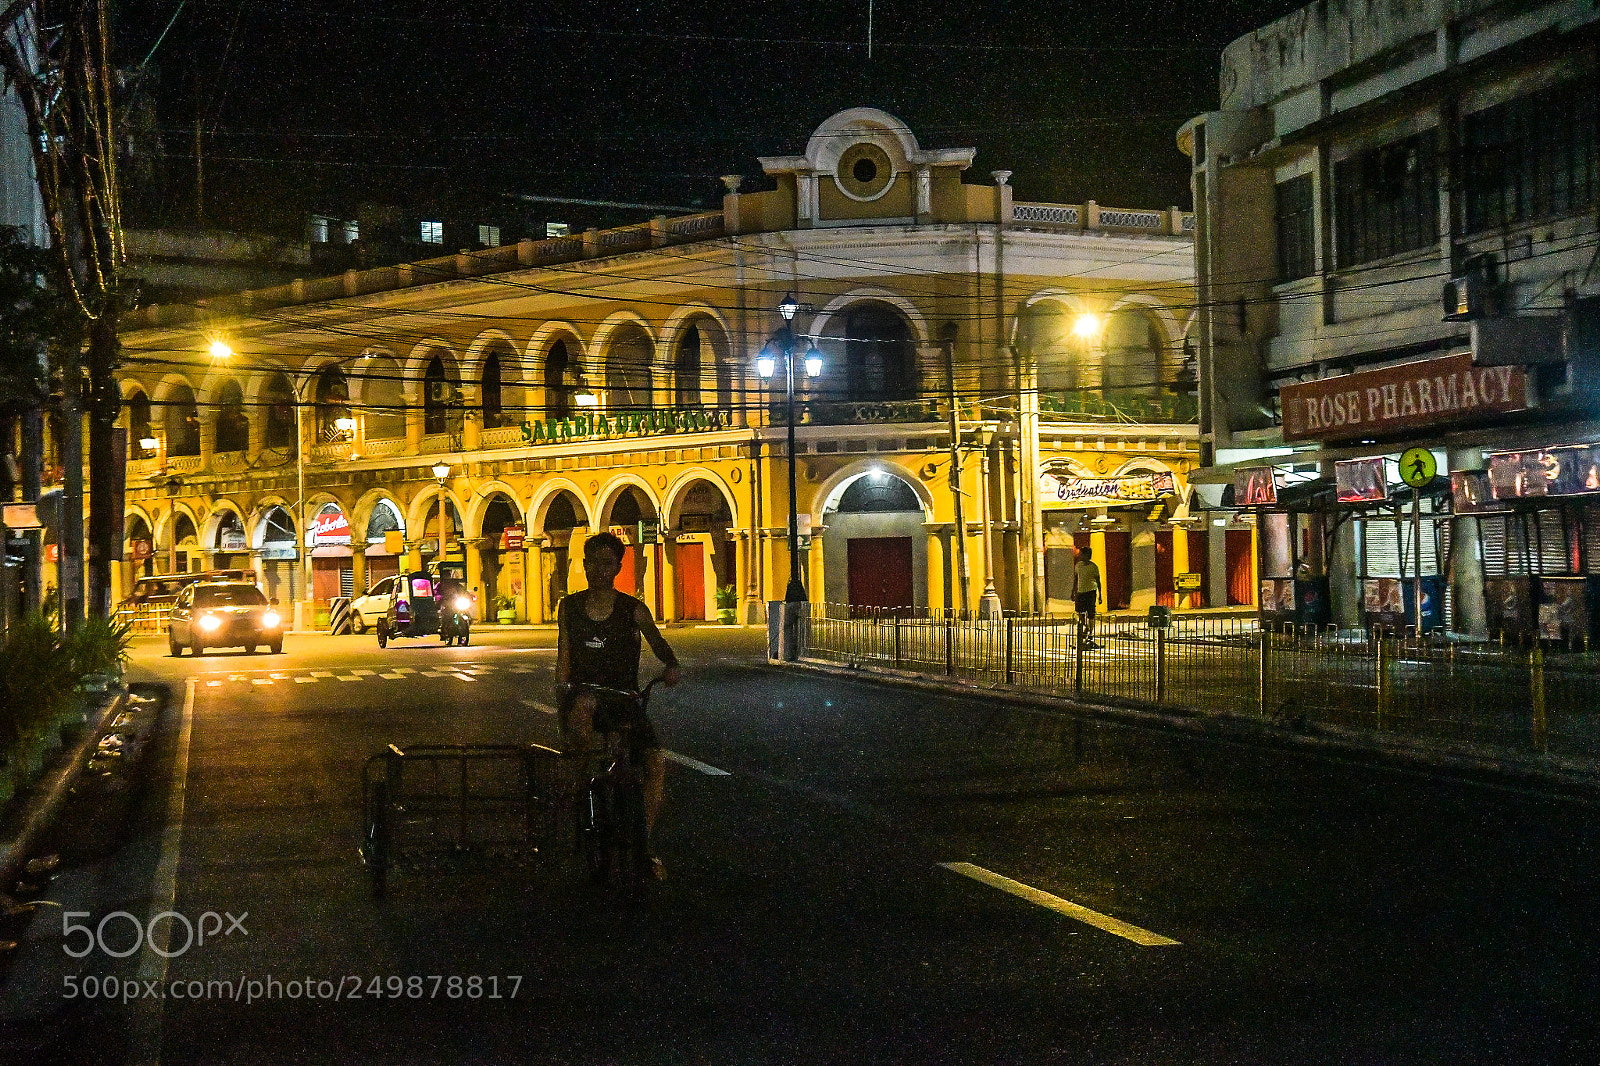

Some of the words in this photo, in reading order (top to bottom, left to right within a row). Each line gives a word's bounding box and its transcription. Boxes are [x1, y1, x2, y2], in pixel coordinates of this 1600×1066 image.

[1307, 391, 1361, 430] ROSE
[1367, 366, 1512, 421] PHARMACY
[520, 413, 610, 441] SARABIA
